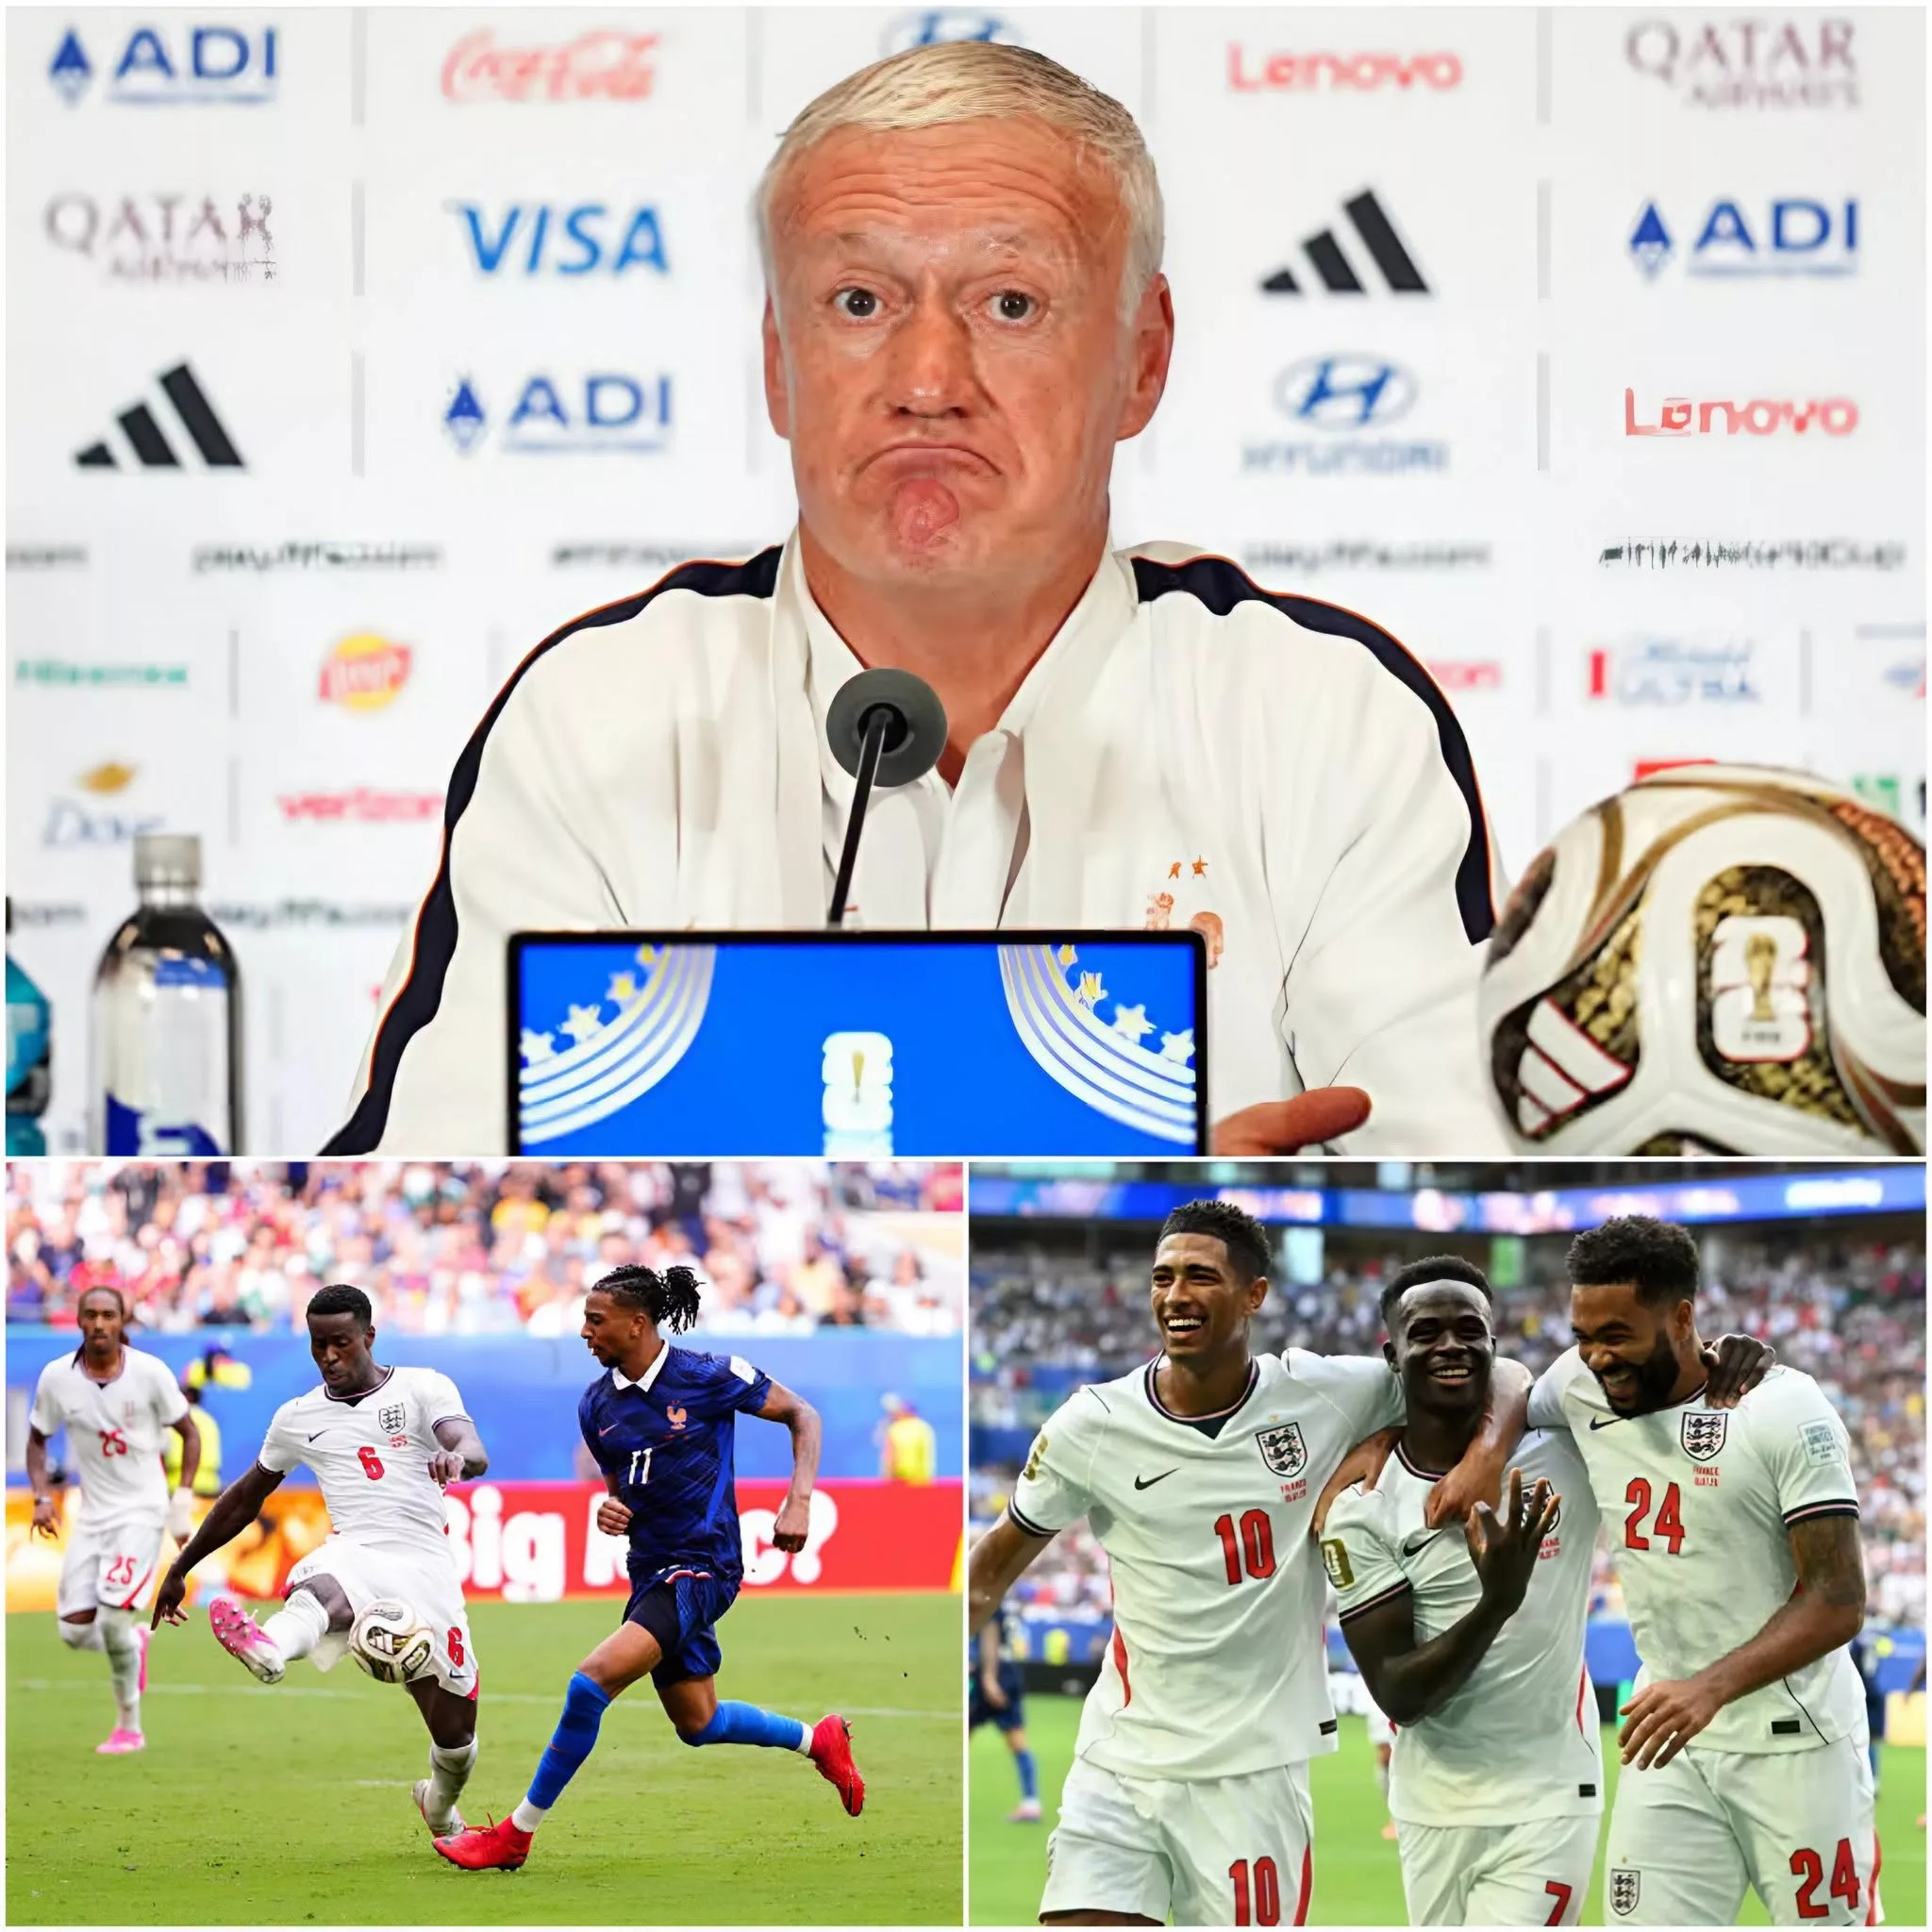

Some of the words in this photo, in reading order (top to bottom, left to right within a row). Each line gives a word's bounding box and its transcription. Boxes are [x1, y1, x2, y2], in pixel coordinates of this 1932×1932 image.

[115, 27, 277, 79] ADI
[1227, 42, 1465, 93] Lenovo
[1624, 18, 1857, 87] QATAR
[460, 203, 671, 276] VISA
[1694, 198, 1858, 253] ADI
[508, 374, 673, 427] ADI
[97, 1426, 129, 1458] 25
[357, 1445, 385, 1481] 6
[628, 1447, 653, 1485] 11
[1624, 1476, 1687, 1555] 24
[105, 1556, 138, 1585] 25
[1213, 1507, 1277, 1586] 10
[446, 1625, 465, 1668] 6
[1228, 1856, 1281, 1927] 10
[1543, 1879, 1574, 1927] 7
[1789, 1838, 1862, 1920] 24
